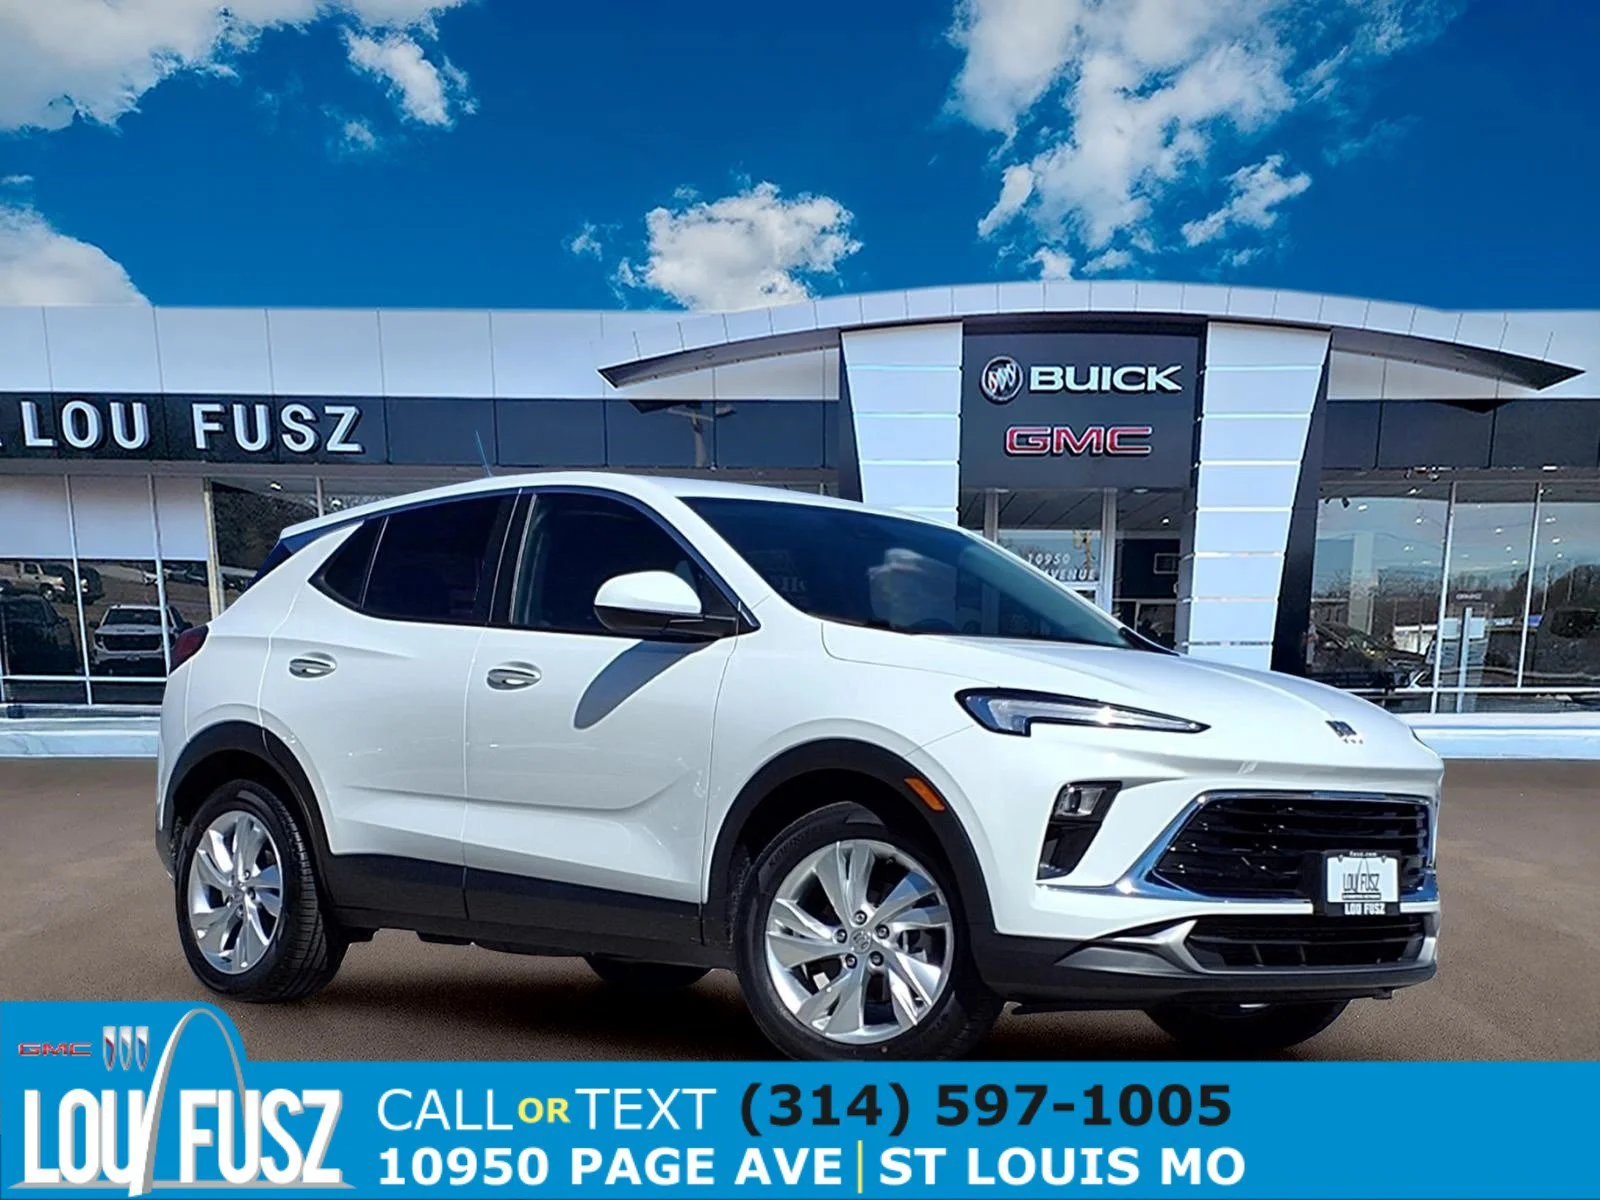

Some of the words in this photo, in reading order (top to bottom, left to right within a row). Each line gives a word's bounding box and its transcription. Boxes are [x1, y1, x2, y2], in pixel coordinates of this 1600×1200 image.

[1029, 365, 1183, 392] BUICK
[20, 400, 150, 449] LOU
[191, 402, 364, 452] FUSZ
[1006, 426, 1153, 455] GMC
[1027, 553, 1071, 565] 10950
[1344, 903, 1363, 915] LOU
[1364, 903, 1386, 915] FUSZ
